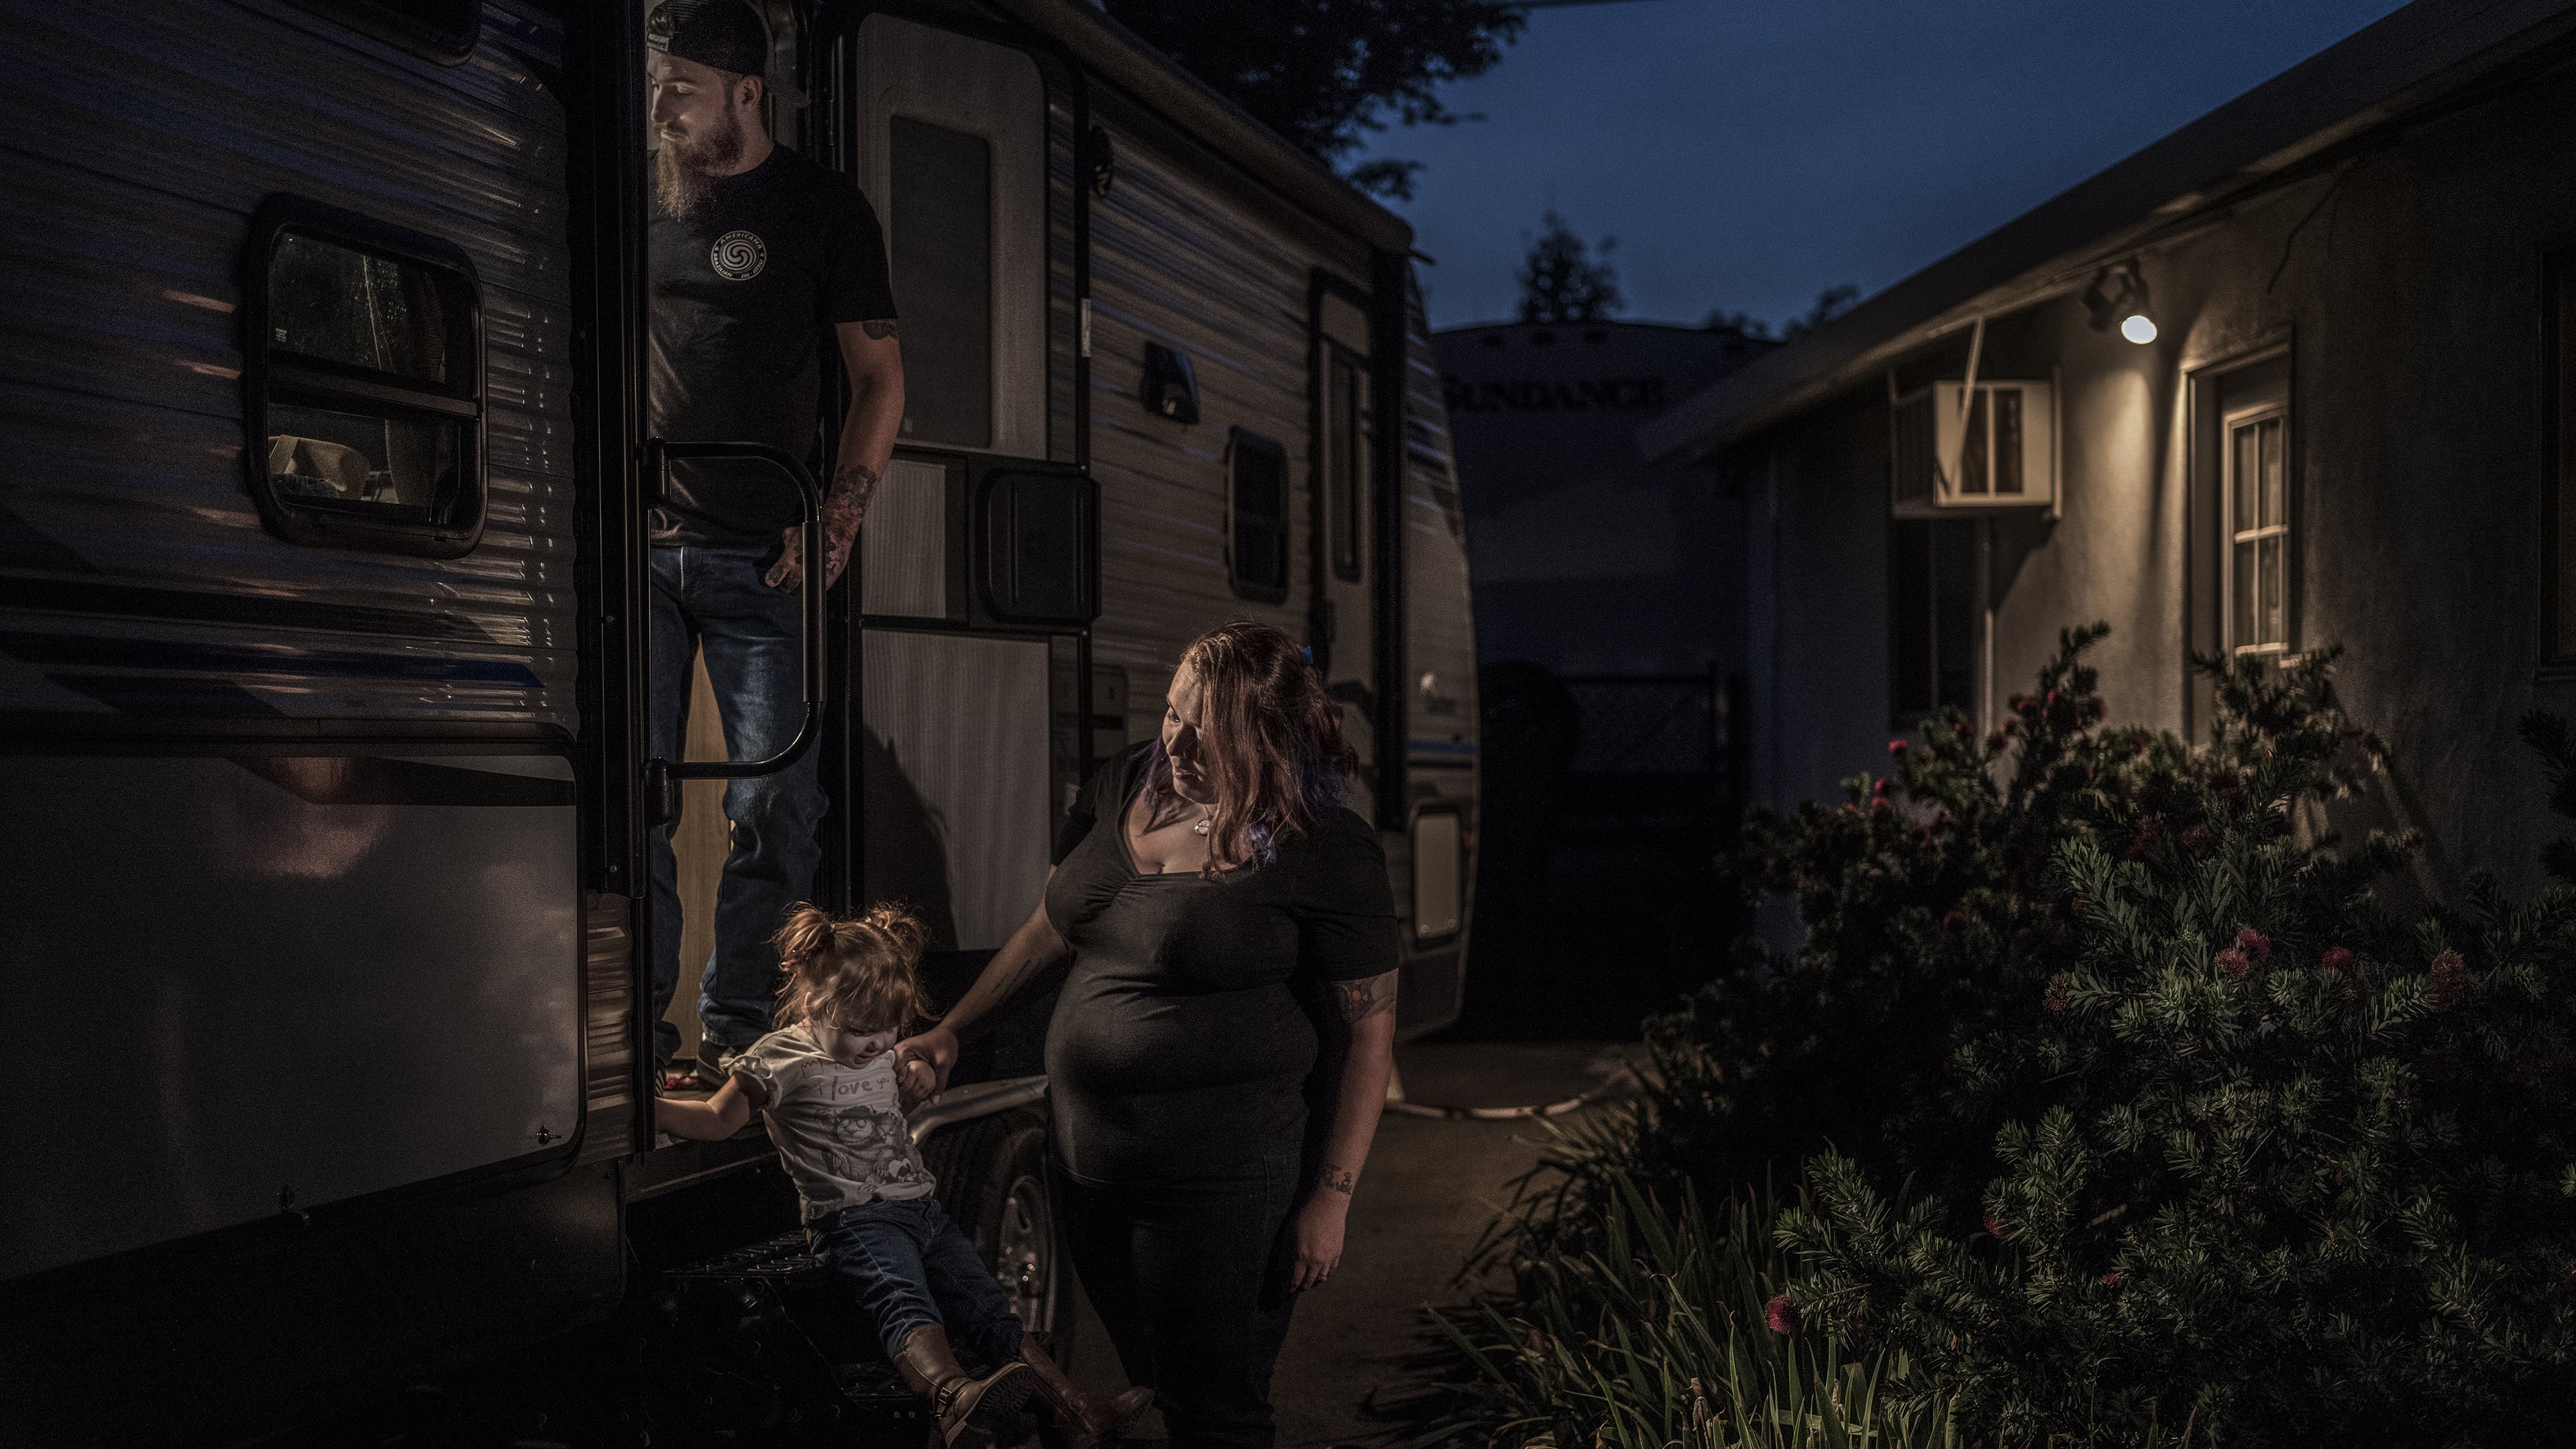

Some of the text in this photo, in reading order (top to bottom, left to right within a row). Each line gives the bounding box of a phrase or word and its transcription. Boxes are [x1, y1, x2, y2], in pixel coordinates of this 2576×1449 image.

[720, 232, 763, 250] AMERICANA
[713, 253, 733, 277] BRAZILIAN
[831, 1076, 873, 1101] love
[876, 1077, 890, 1089] you
